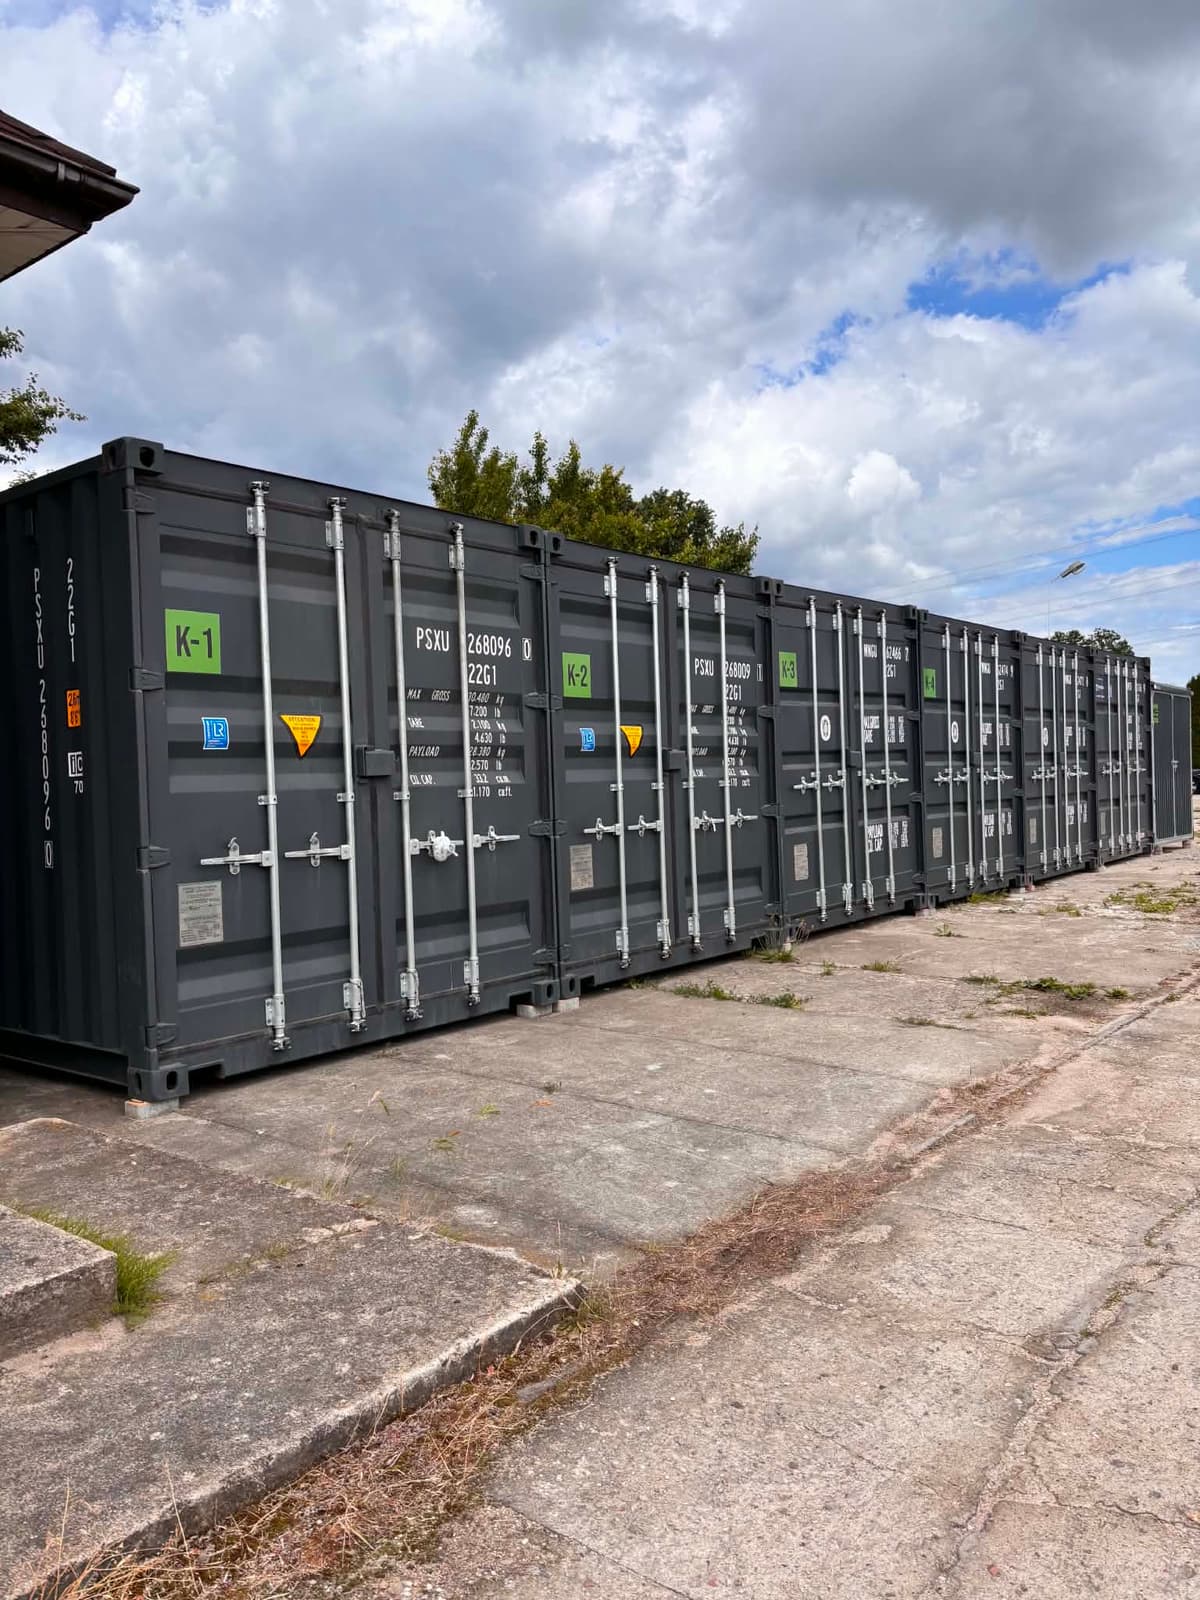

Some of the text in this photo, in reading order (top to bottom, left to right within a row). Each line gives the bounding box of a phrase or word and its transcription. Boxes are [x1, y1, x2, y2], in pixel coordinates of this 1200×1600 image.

[67, 557, 75, 663] 22G1
[176, 625, 212, 658] K-1
[416, 626, 532, 660] PSXU 268096 0
[467, 663, 496, 685] 22G1
[568, 663, 588, 687] K-2
[694, 657, 714, 676] PSXU
[724, 660, 751, 679] 268009
[782, 660, 795, 679] K-3
[34, 567, 44, 669] PSXU
[40, 679, 51, 830] 268096
[407, 689, 422, 699] MAX
[431, 690, 451, 702] GROSS
[469, 705, 487, 718] 7.200
[409, 746, 439, 757] PAYLOAD
[470, 758, 488, 771] 2.570
[74, 780, 83, 794] 70
